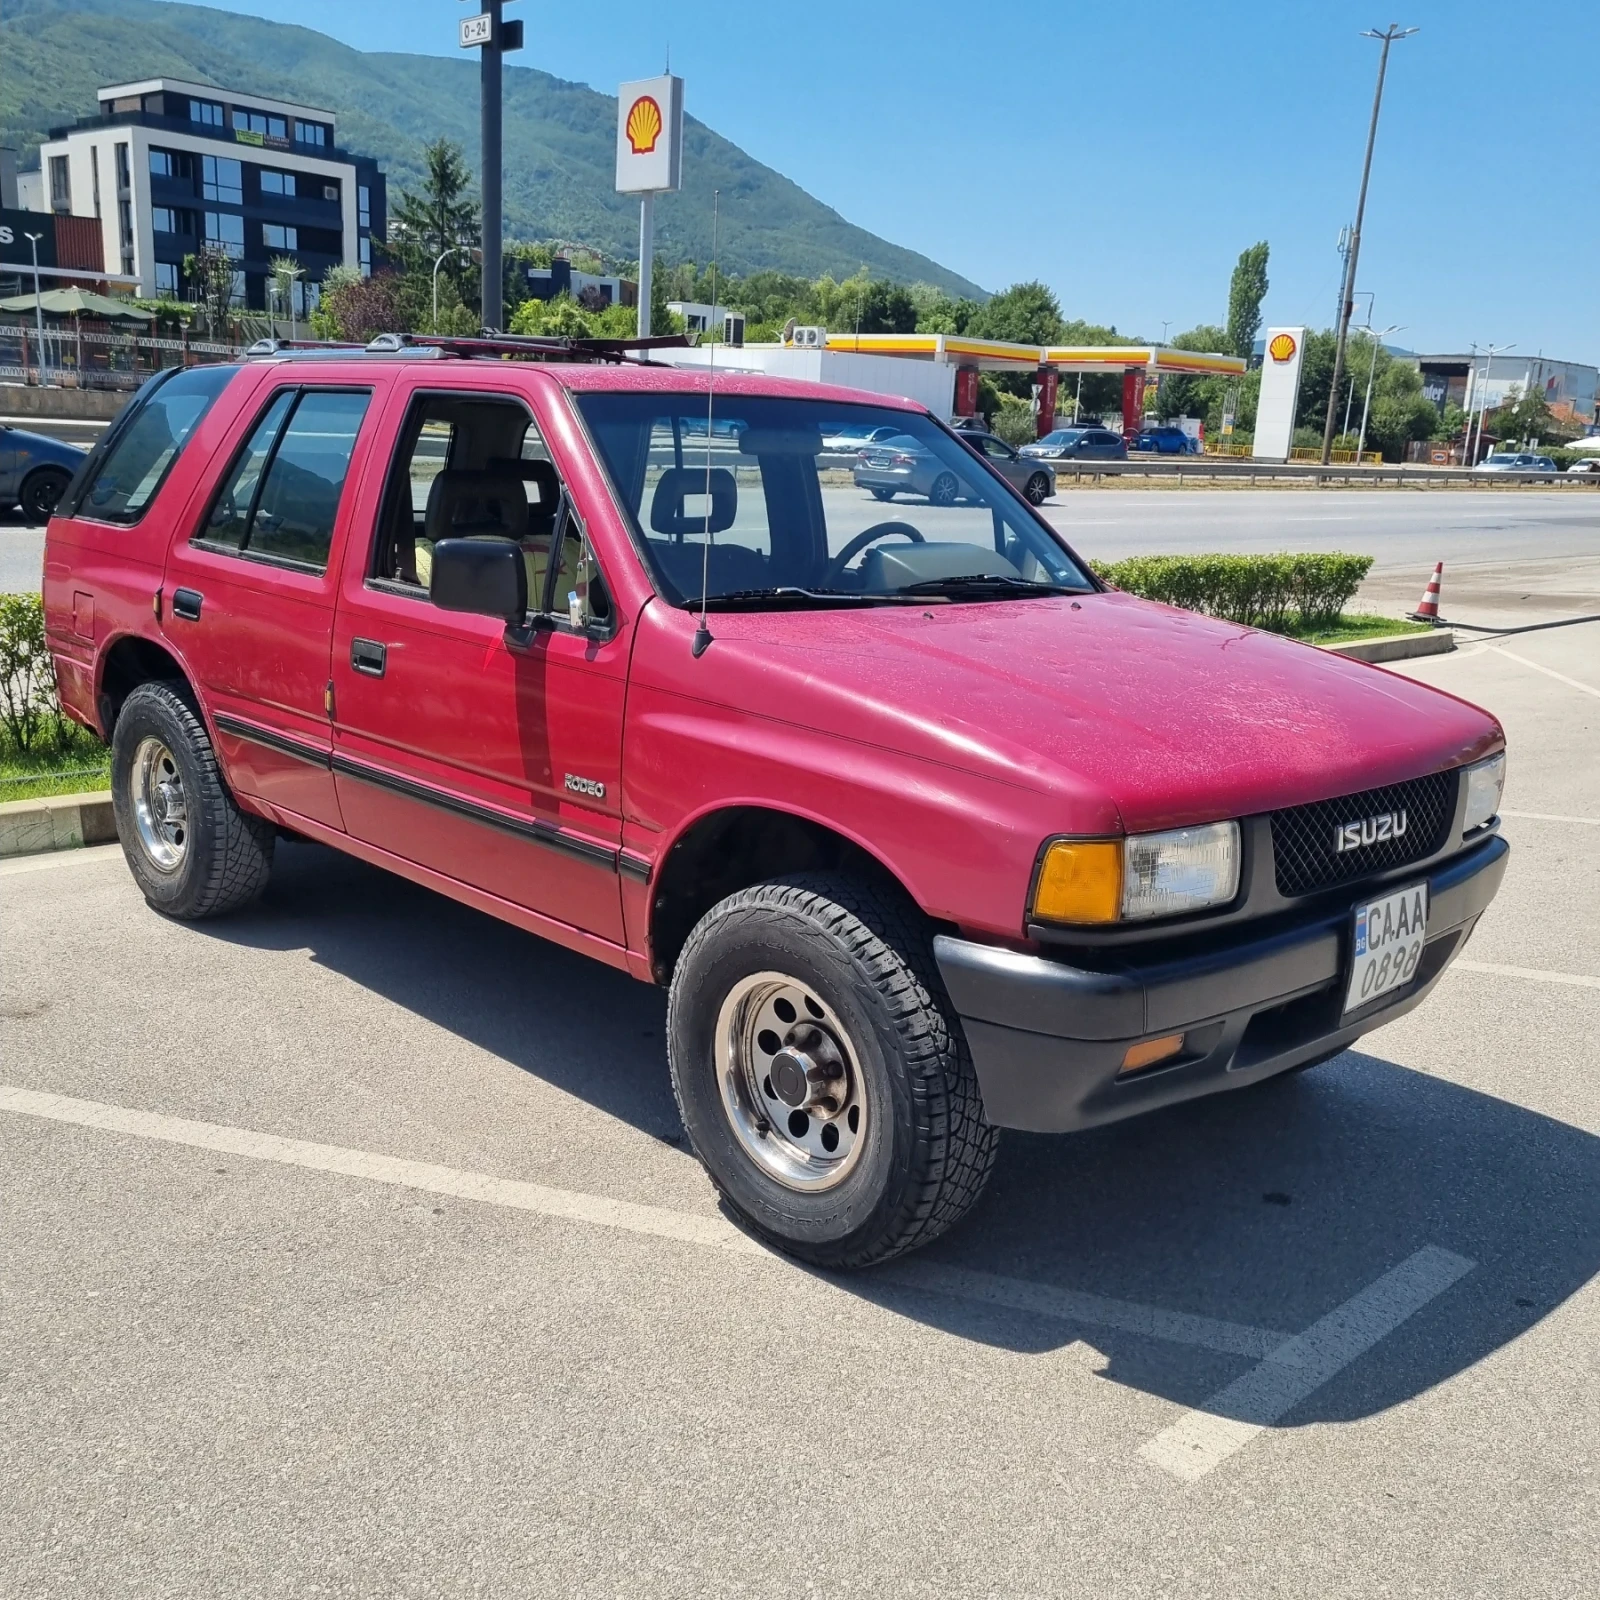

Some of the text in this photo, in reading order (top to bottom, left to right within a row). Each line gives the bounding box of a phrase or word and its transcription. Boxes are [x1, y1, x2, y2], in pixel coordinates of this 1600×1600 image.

[464, 21, 486, 38] 0-24
[564, 772, 605, 797] RODEO
[1337, 808, 1407, 852] ISUZU
[1356, 937, 1366, 952] BG
[1361, 940, 1421, 999] 0898
